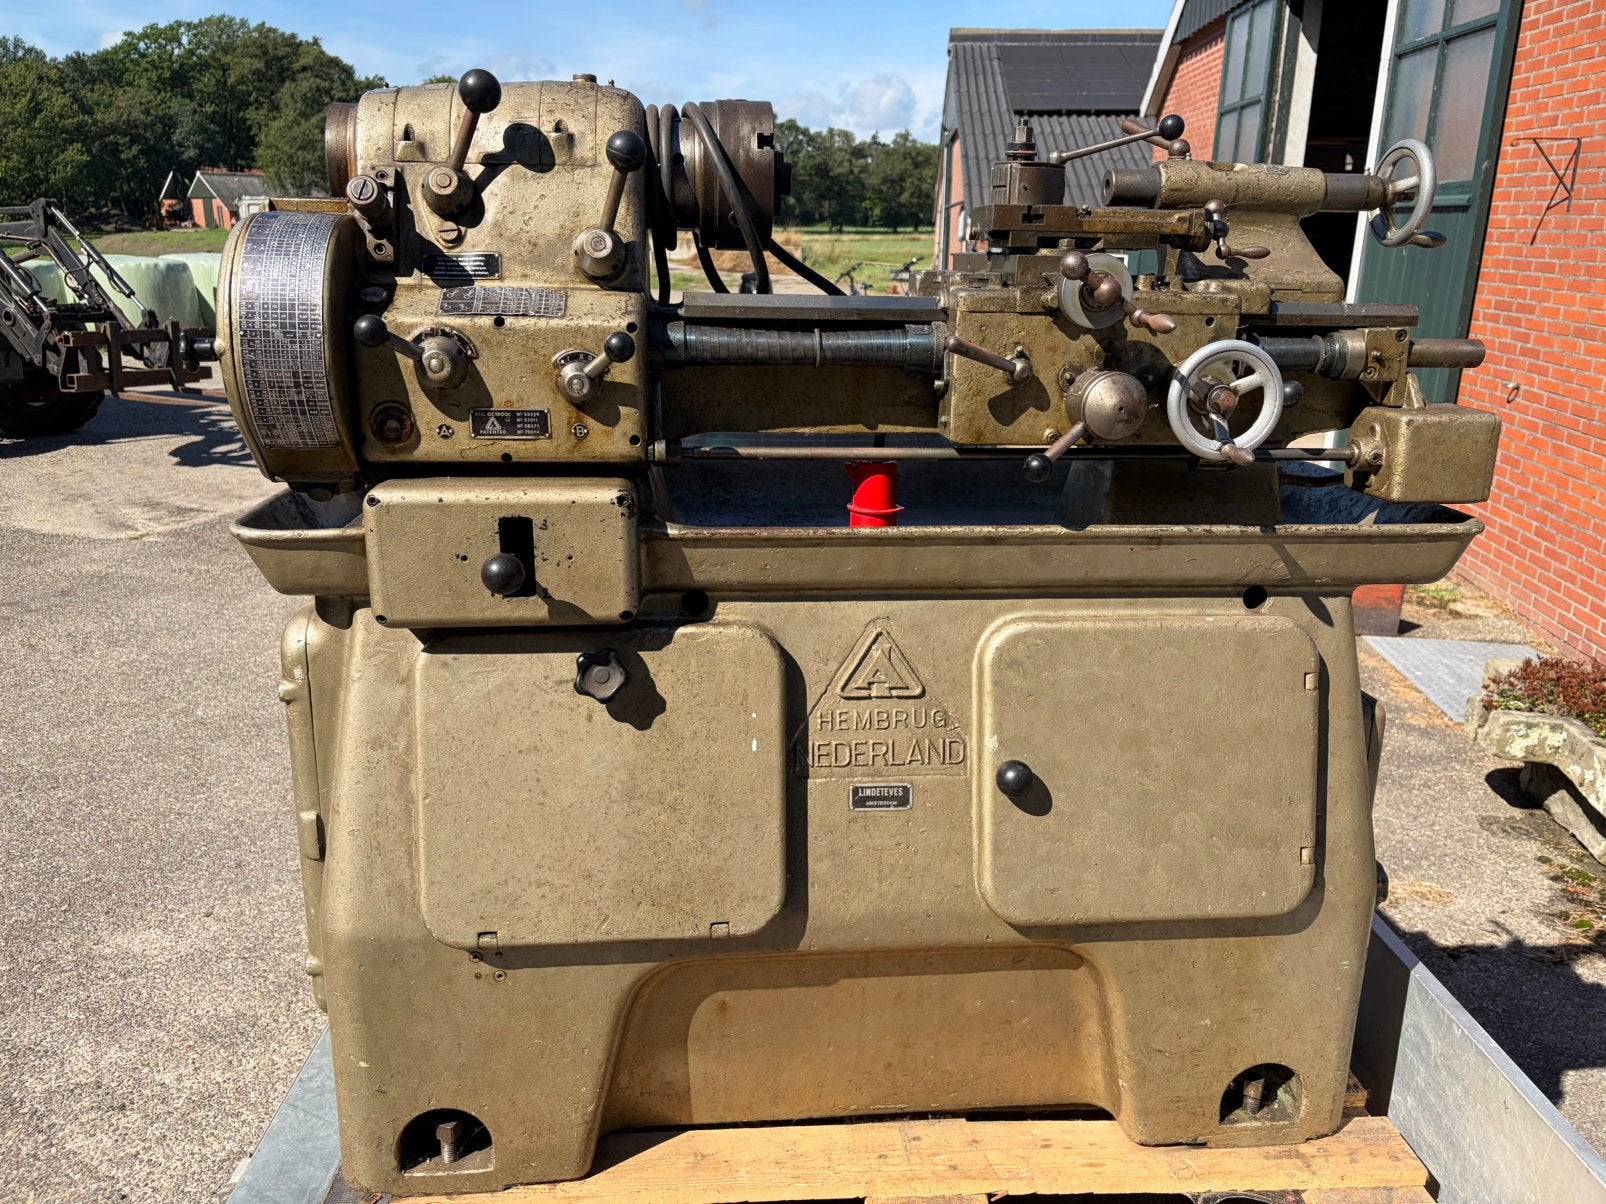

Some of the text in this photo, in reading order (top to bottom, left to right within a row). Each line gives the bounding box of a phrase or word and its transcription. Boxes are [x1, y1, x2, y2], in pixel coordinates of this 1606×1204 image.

[440, 426, 450, 436] A
[576, 426, 585, 436] B
[817, 708, 948, 732] HEMBRUG
[858, 787, 904, 797] LINDETEVES
